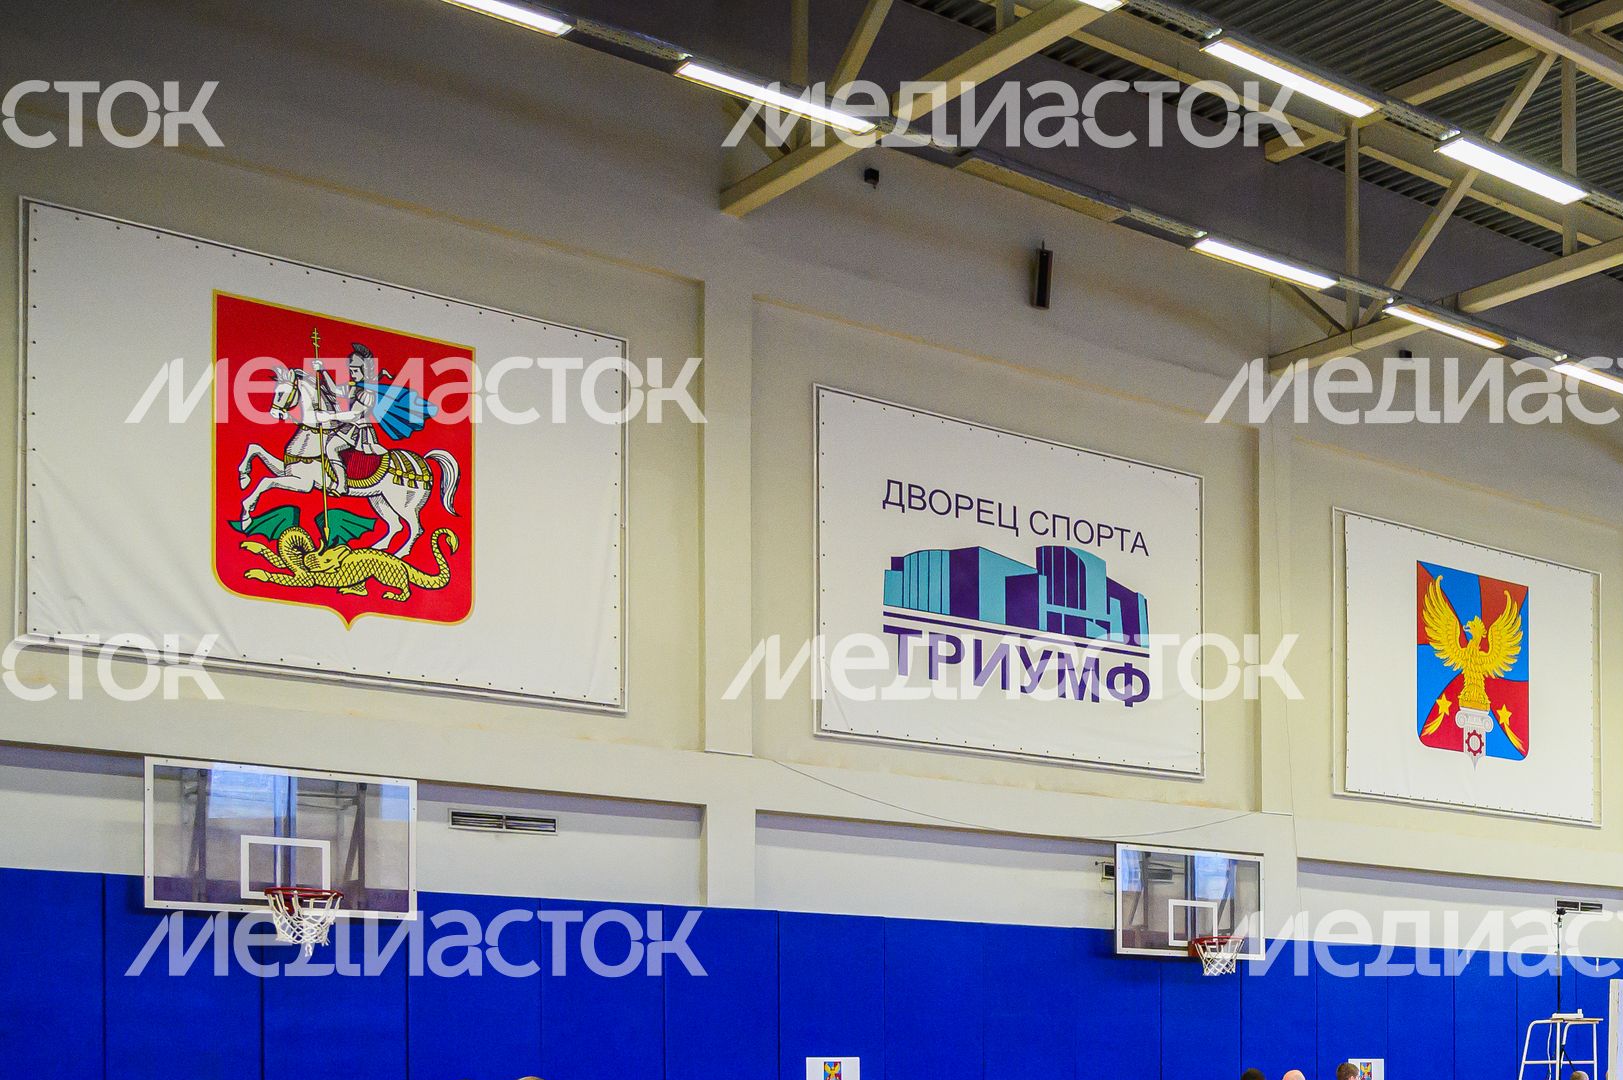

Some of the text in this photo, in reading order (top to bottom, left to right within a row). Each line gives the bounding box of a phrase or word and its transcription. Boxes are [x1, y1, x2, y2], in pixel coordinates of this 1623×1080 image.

[882, 479, 1150, 557] ДВОРЕЦ СПОРТА
[883, 624, 1151, 708] ТРИУМФ
